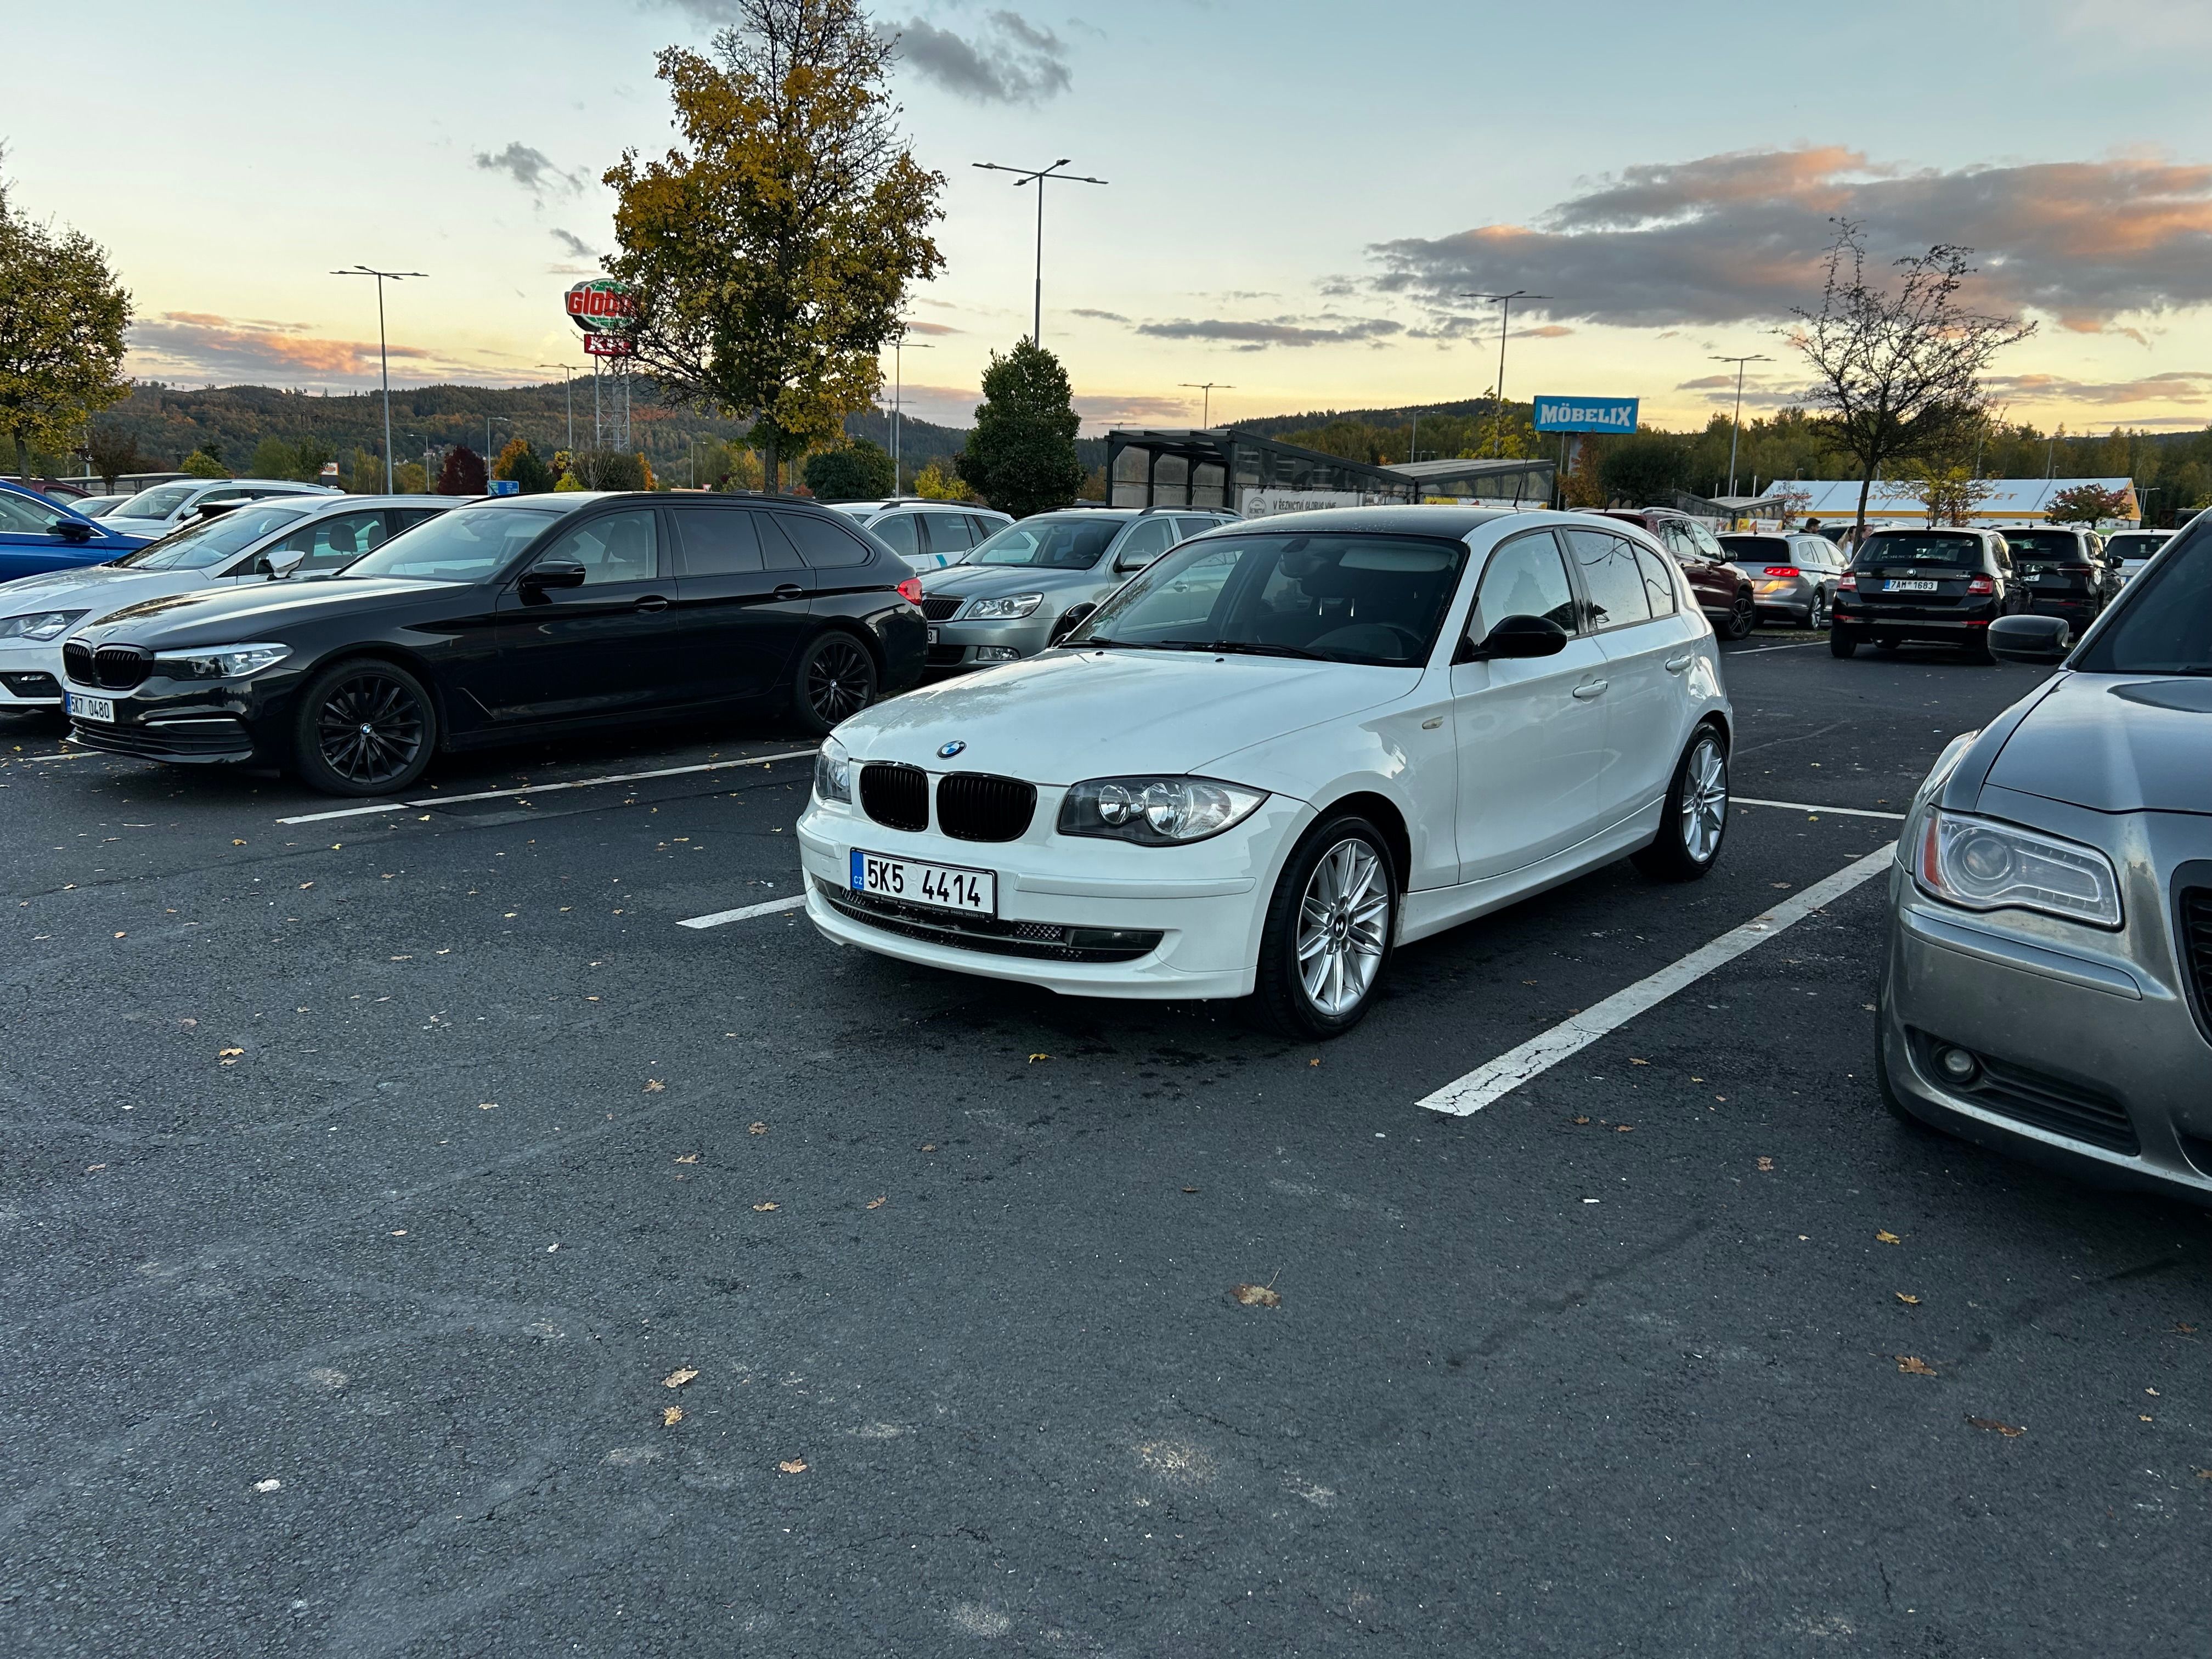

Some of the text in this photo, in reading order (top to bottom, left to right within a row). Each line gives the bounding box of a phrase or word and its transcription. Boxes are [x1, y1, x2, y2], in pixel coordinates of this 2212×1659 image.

[1540, 403, 1632, 427] MÖBELIX
[1273, 500, 1278, 510] V
[1278, 498, 1304, 511] ŘEZNICTVÍ
[1305, 500, 1324, 510] GLOBUS
[1914, 582, 1933, 590] 1683
[71, 696, 83, 714] 5K7
[88, 699, 110, 719] 0480
[854, 875, 864, 885] CZ
[868, 859, 981, 907] 5K5 4414
